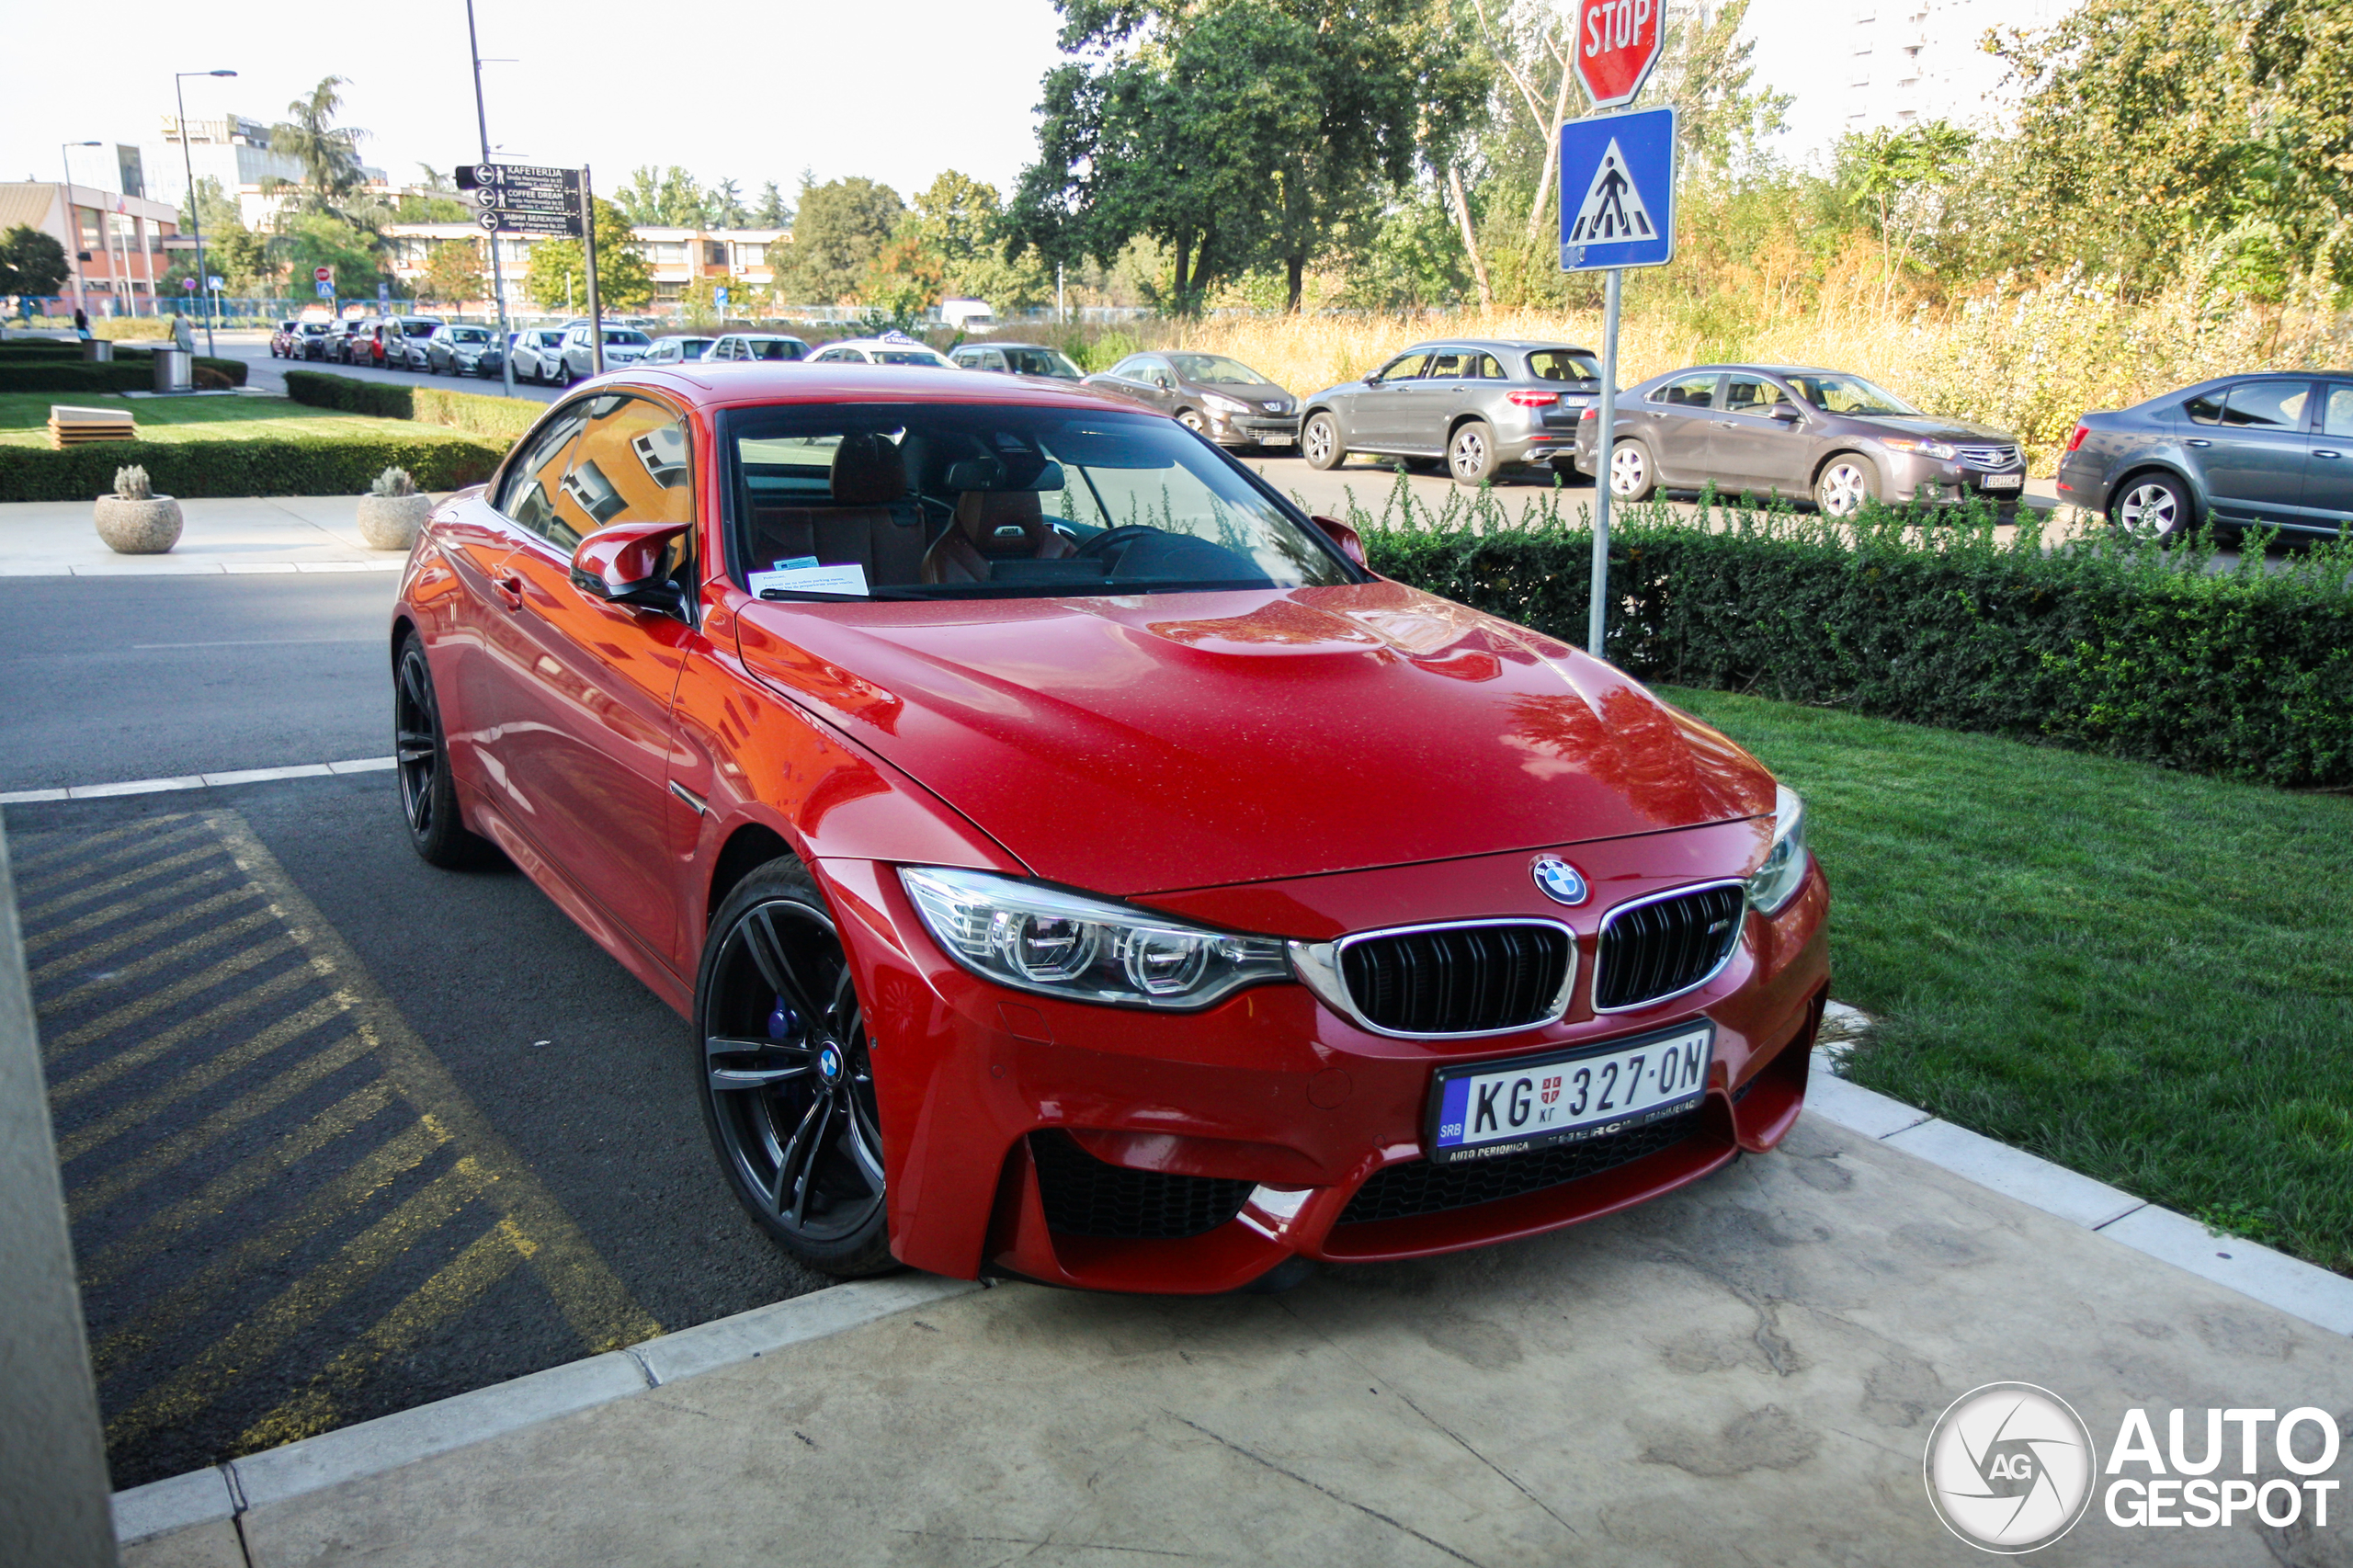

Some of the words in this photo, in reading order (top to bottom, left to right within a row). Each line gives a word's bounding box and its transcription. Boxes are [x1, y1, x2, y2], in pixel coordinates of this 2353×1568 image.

[1586, 0, 1650, 57] STOP
[506, 165, 563, 177] KAFETERIJA
[507, 189, 536, 198] COFFEE
[538, 191, 563, 200] DREAM
[717, 289, 724, 299] P
[1536, 860, 1573, 876] BMW
[1473, 1076, 1533, 1134] KG
[1439, 1123, 1461, 1139] SRB
[1449, 1149, 1475, 1162] AUTO
[1477, 1141, 1529, 1158] PERIONICA
